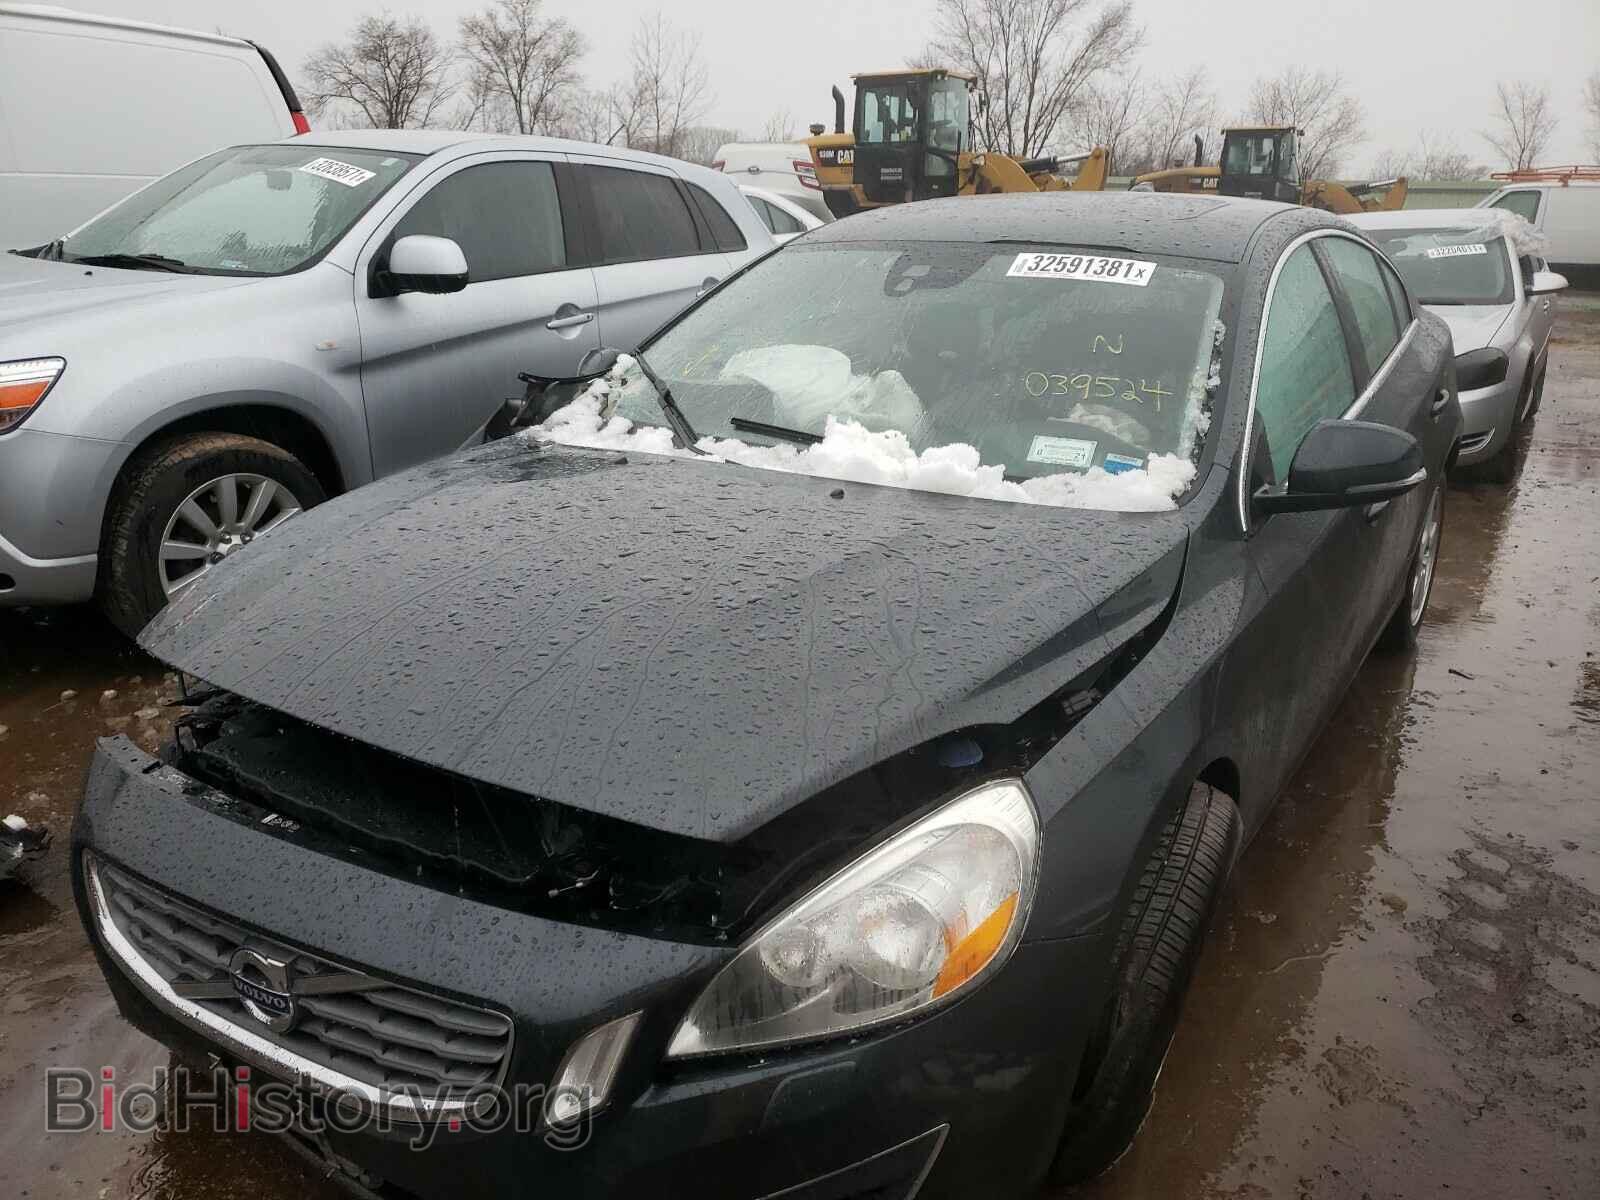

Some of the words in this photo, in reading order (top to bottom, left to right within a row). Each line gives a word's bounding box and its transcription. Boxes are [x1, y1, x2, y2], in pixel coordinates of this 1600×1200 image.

[837, 149, 855, 164] CAT
[1025, 371, 1176, 412] 039524
[239, 982, 286, 1008] VOLVO
